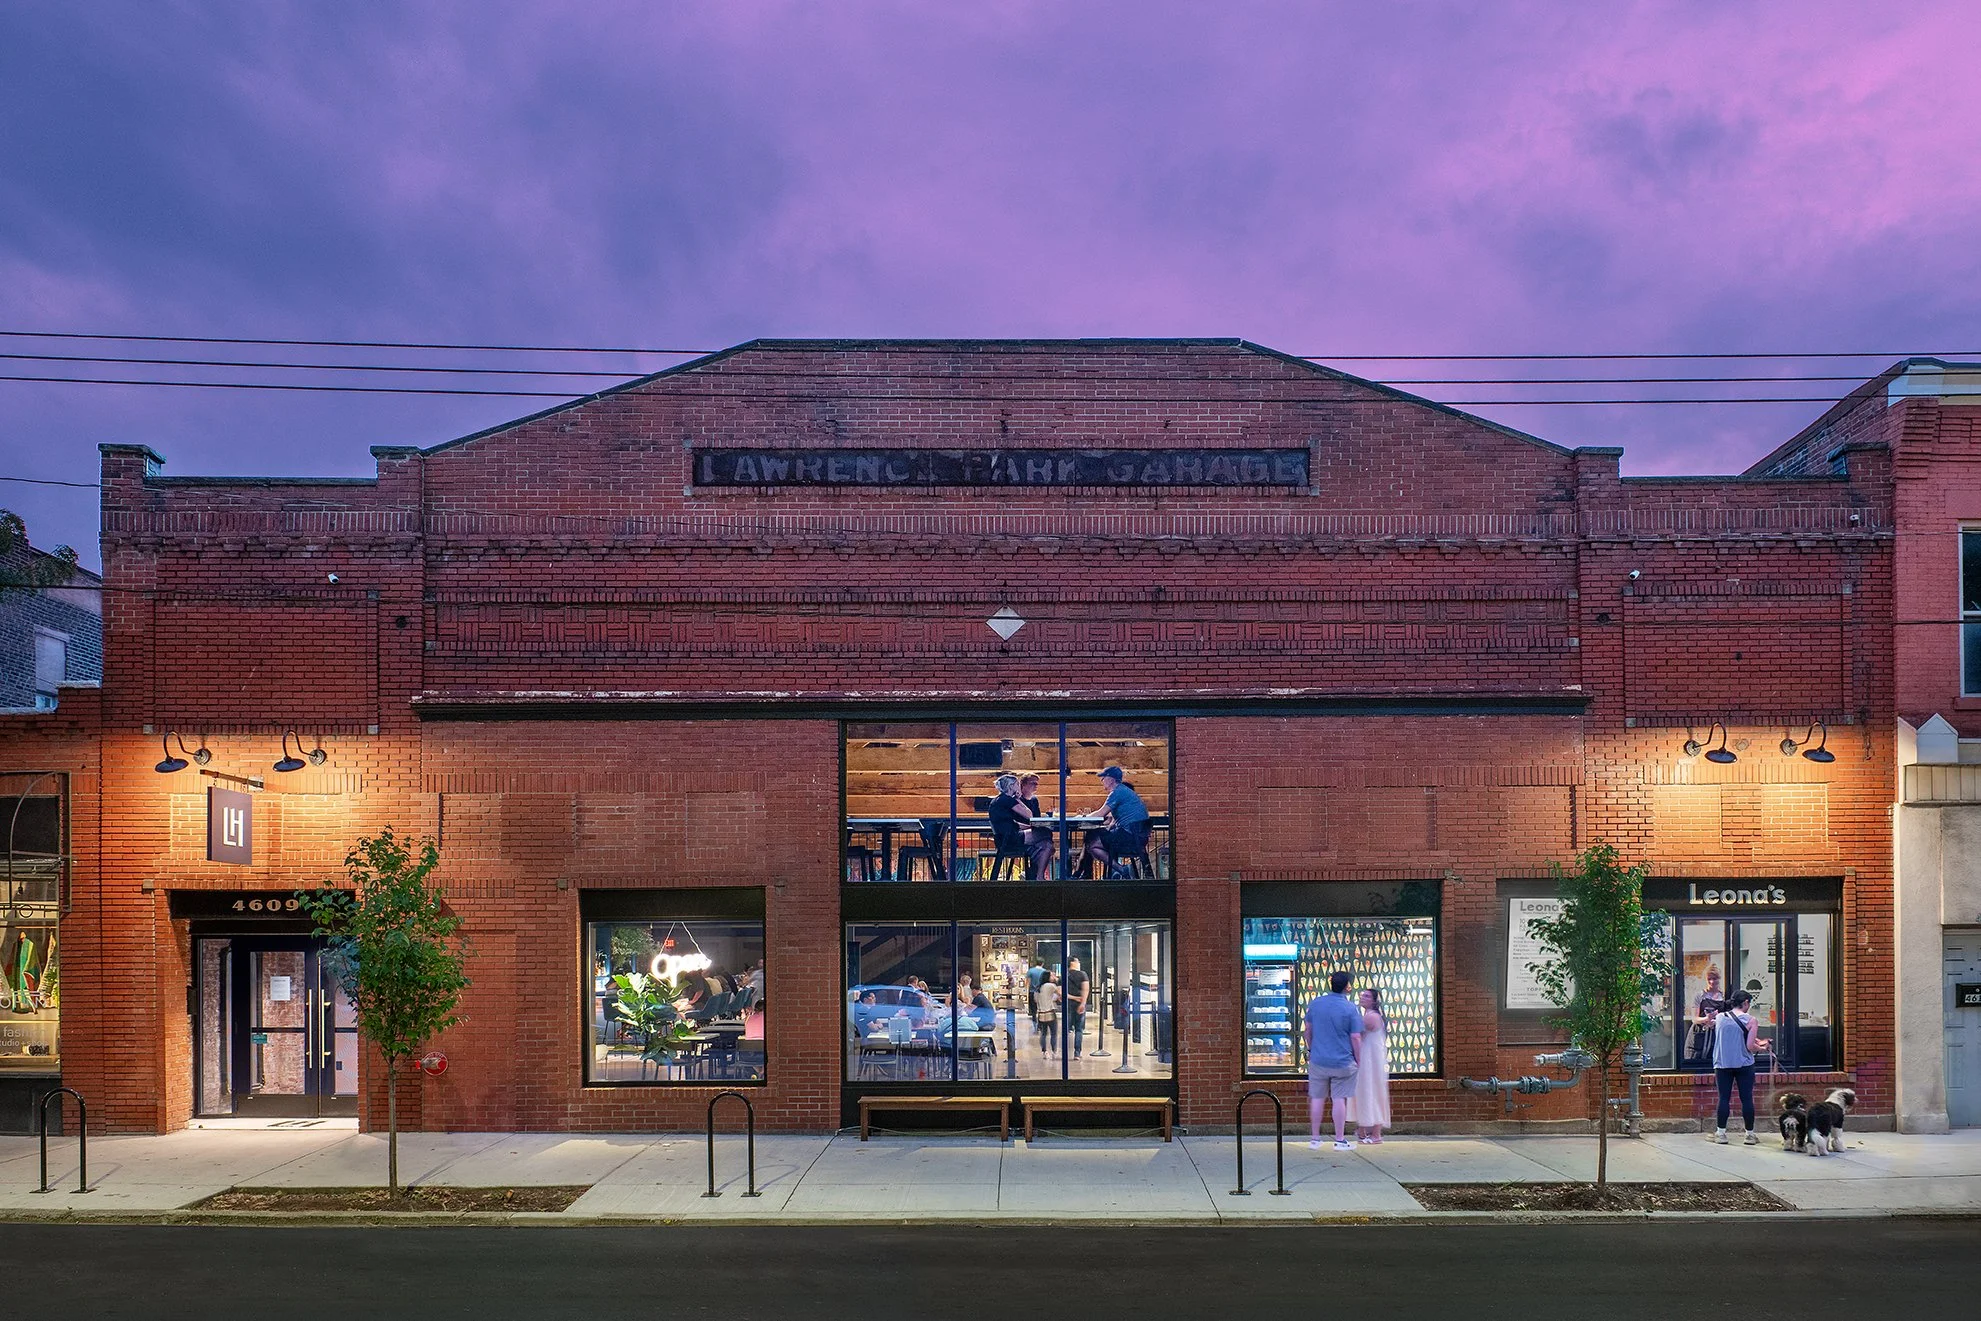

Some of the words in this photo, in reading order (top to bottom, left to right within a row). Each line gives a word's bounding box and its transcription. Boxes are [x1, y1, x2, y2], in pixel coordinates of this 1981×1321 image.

[702, 455, 937, 482] LAWRENC
[1106, 456, 1308, 484] GARAGE
[223, 806, 244, 847] LH
[1689, 883, 1787, 905] Leona's
[232, 899, 299, 912] 4609
[1520, 901, 1562, 912] Leona
